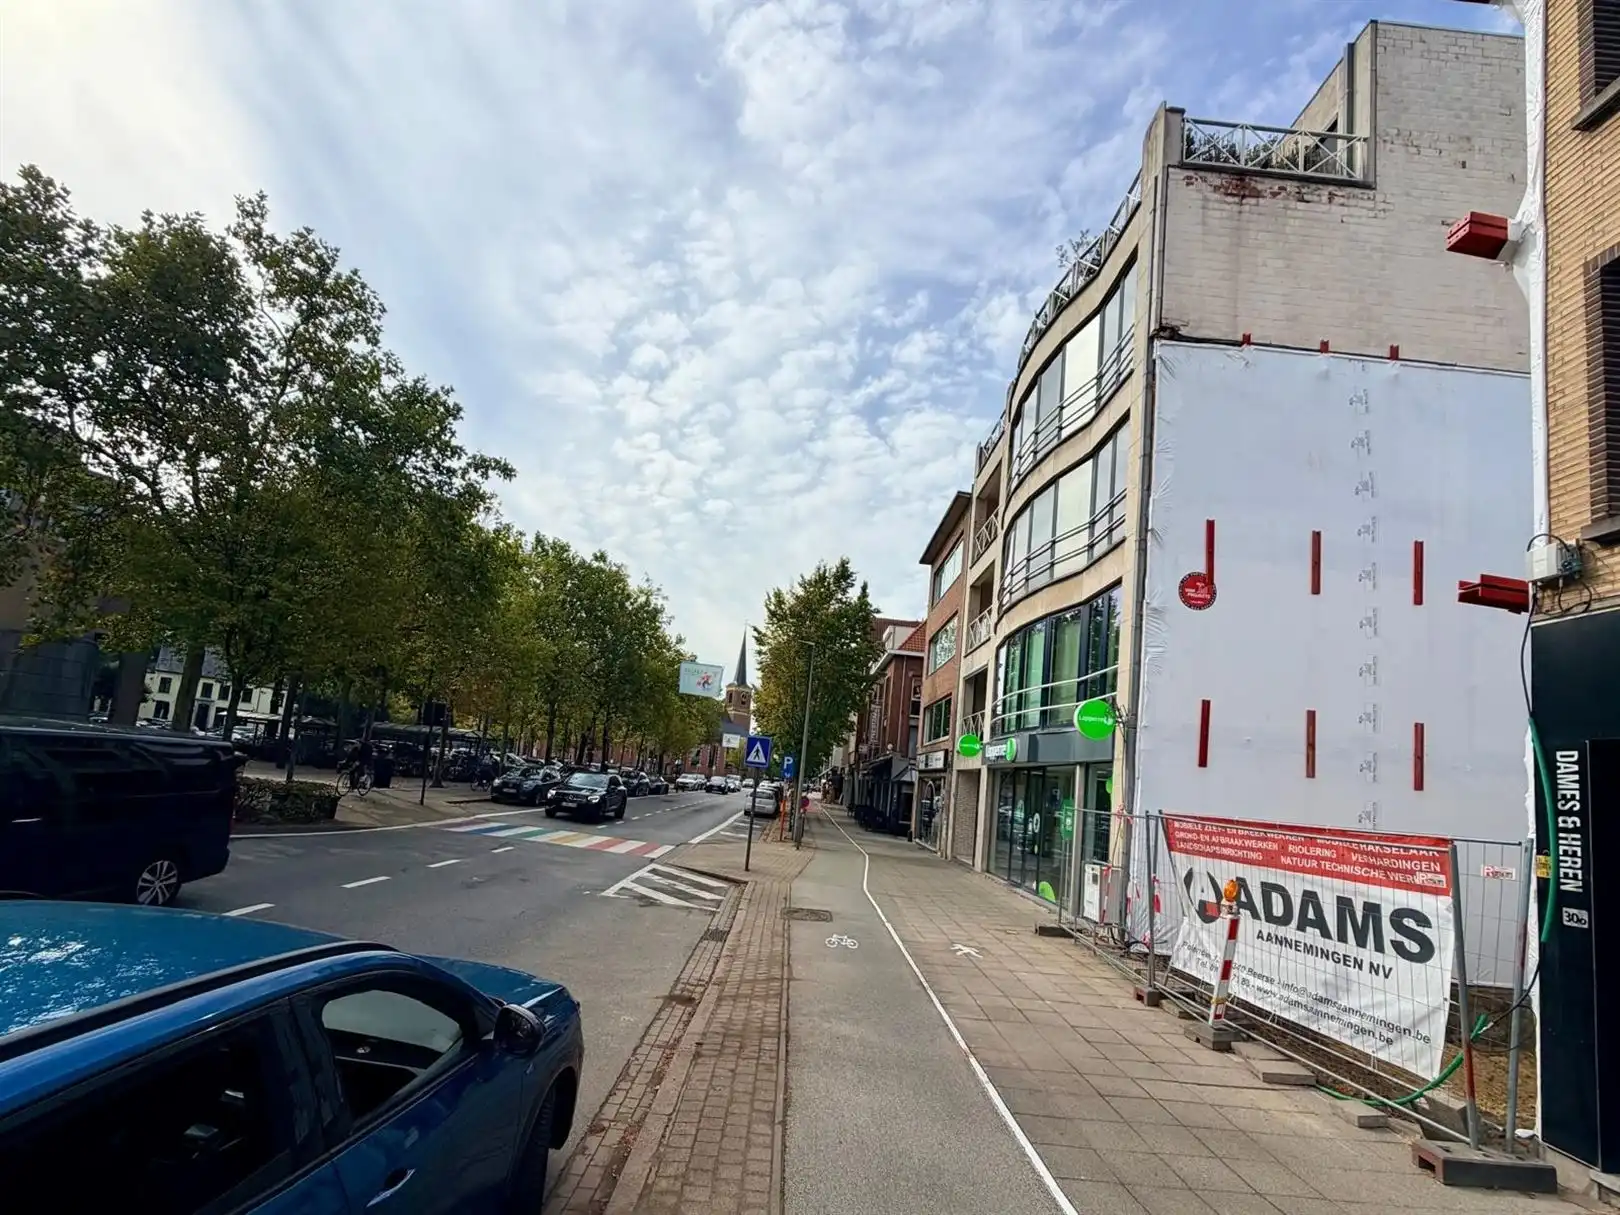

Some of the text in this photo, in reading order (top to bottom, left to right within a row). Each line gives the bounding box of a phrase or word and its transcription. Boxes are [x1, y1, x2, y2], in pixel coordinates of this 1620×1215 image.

[784, 756, 793, 769] P
[1556, 750, 1583, 893] DAMES & HEREN
[1280, 855, 1319, 869] NATUUR
[1319, 860, 1385, 880] TECHNISCHE
[1288, 844, 1337, 859] RIOLERING
[1351, 851, 1441, 873] VERHARDINGEN
[1234, 876, 1436, 964] ADAMS
[1256, 929, 1394, 981] AANNEMINGEN NV
[1247, 967, 1275, 985] Beerse
